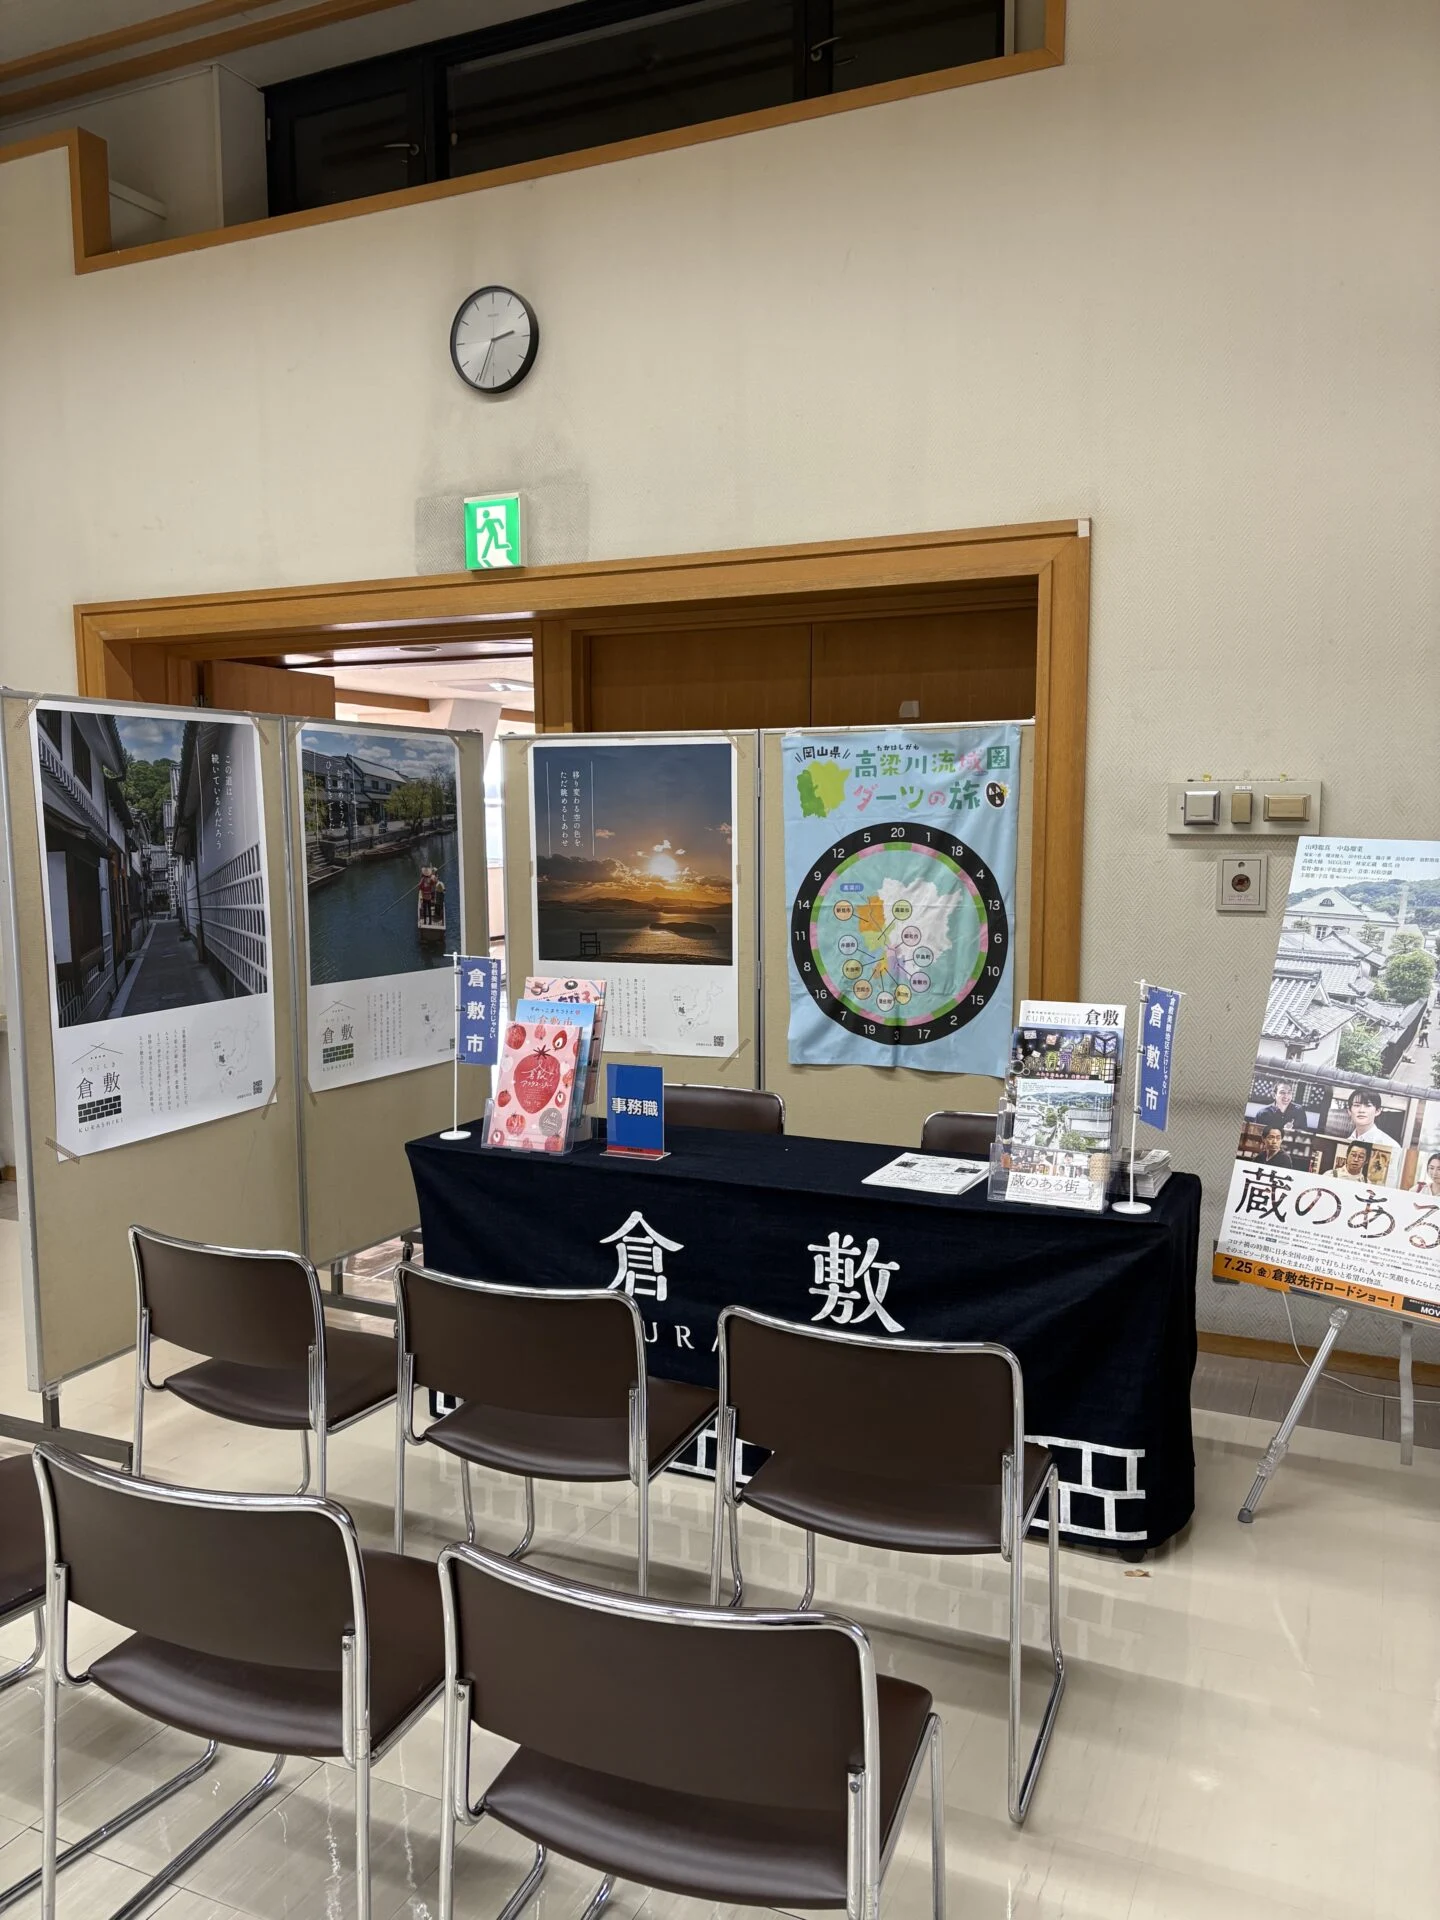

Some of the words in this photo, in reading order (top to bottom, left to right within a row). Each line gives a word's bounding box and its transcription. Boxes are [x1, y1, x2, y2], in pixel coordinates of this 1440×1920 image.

[802, 745, 841, 759] 岡山県
[855, 745, 1010, 778] 高梁川流域圏
[224, 754, 235, 836] この道は、どこへ
[853, 779, 981, 811] ダーツの旅
[211, 753, 222, 850] 続いているんだろう
[560, 771, 569, 847] ただ眺めるしあわせ
[572, 770, 584, 847] 移り変わる空の色を、
[863, 832, 871, 843] 5
[890, 826, 906, 839] 20
[926, 831, 931, 843] 1
[832, 848, 845, 859] 12
[951, 845, 964, 857] 18
[813, 870, 822, 881] 9
[976, 869, 985, 880] 4
[797, 900, 810, 911] 14
[988, 899, 1001, 911] 13
[794, 930, 807, 941] 11
[994, 933, 1002, 944] 6
[803, 961, 812, 973] 8
[987, 965, 1000, 977] 10
[814, 988, 828, 1000] 16
[971, 994, 985, 1006] 15
[465, 968, 486, 1054] 倉敷市
[840, 1010, 848, 1022] 7
[950, 1015, 958, 1026] 2
[1025, 1014, 1081, 1025] KURASHIKI
[1085, 1008, 1120, 1027] 倉敷
[322, 1023, 354, 1045] 倉敷
[863, 1024, 876, 1036] 19
[894, 1030, 900, 1042] 3
[917, 1028, 931, 1040] 17
[1145, 1003, 1165, 1111] 倉敷市
[77, 1071, 121, 1101] 倉敷
[611, 1097, 659, 1117] 事務職
[78, 1117, 124, 1133] KURASHIKI
[1010, 1173, 1080, 1195] 蔵のある街
[1234, 1167, 1440, 1250] 蔵のある
[599, 1210, 905, 1333] 倉敷
